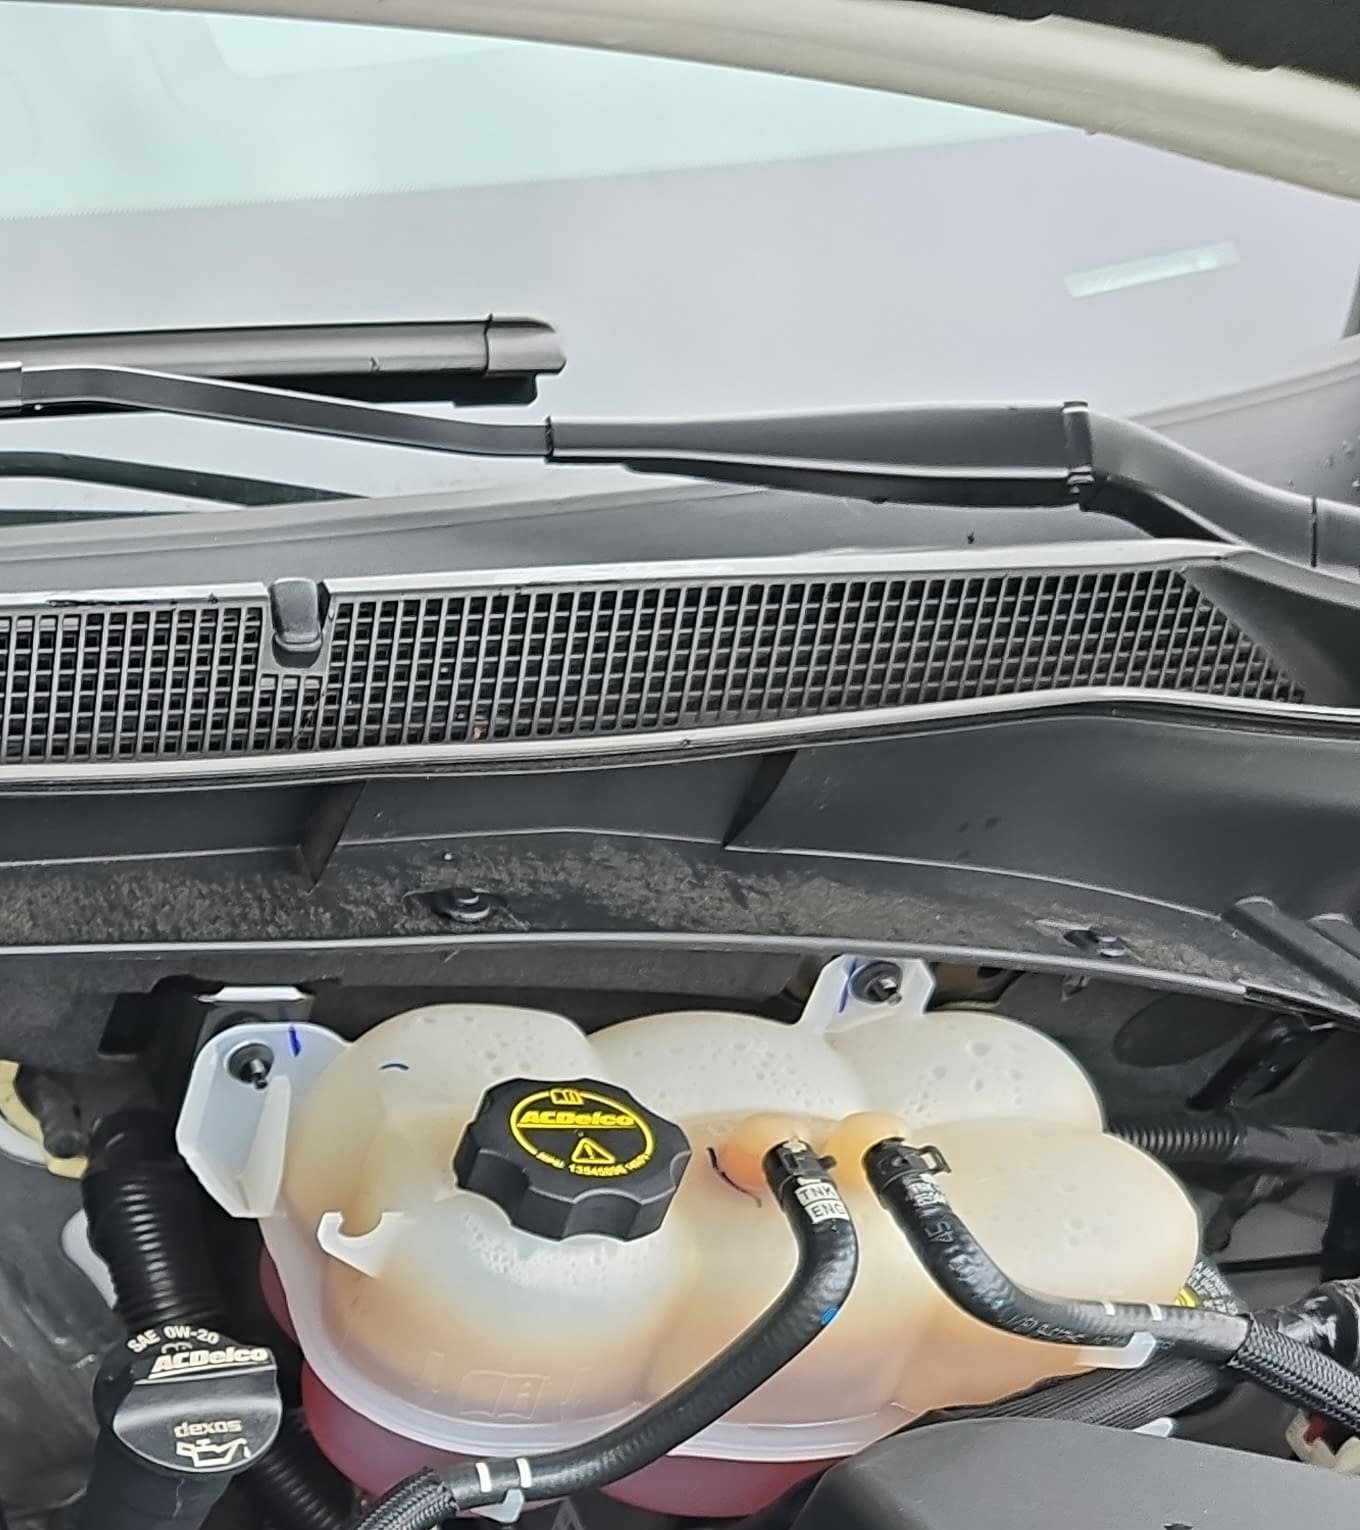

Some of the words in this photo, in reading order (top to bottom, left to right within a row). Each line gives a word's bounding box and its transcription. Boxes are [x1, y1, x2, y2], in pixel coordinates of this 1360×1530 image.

[517, 1109, 637, 1127] ACDelco
[126, 1329, 160, 1353] SAE
[163, 1325, 219, 1345] 0W-20
[150, 1346, 268, 1373] ACDelco
[174, 1420, 242, 1438] dexos
